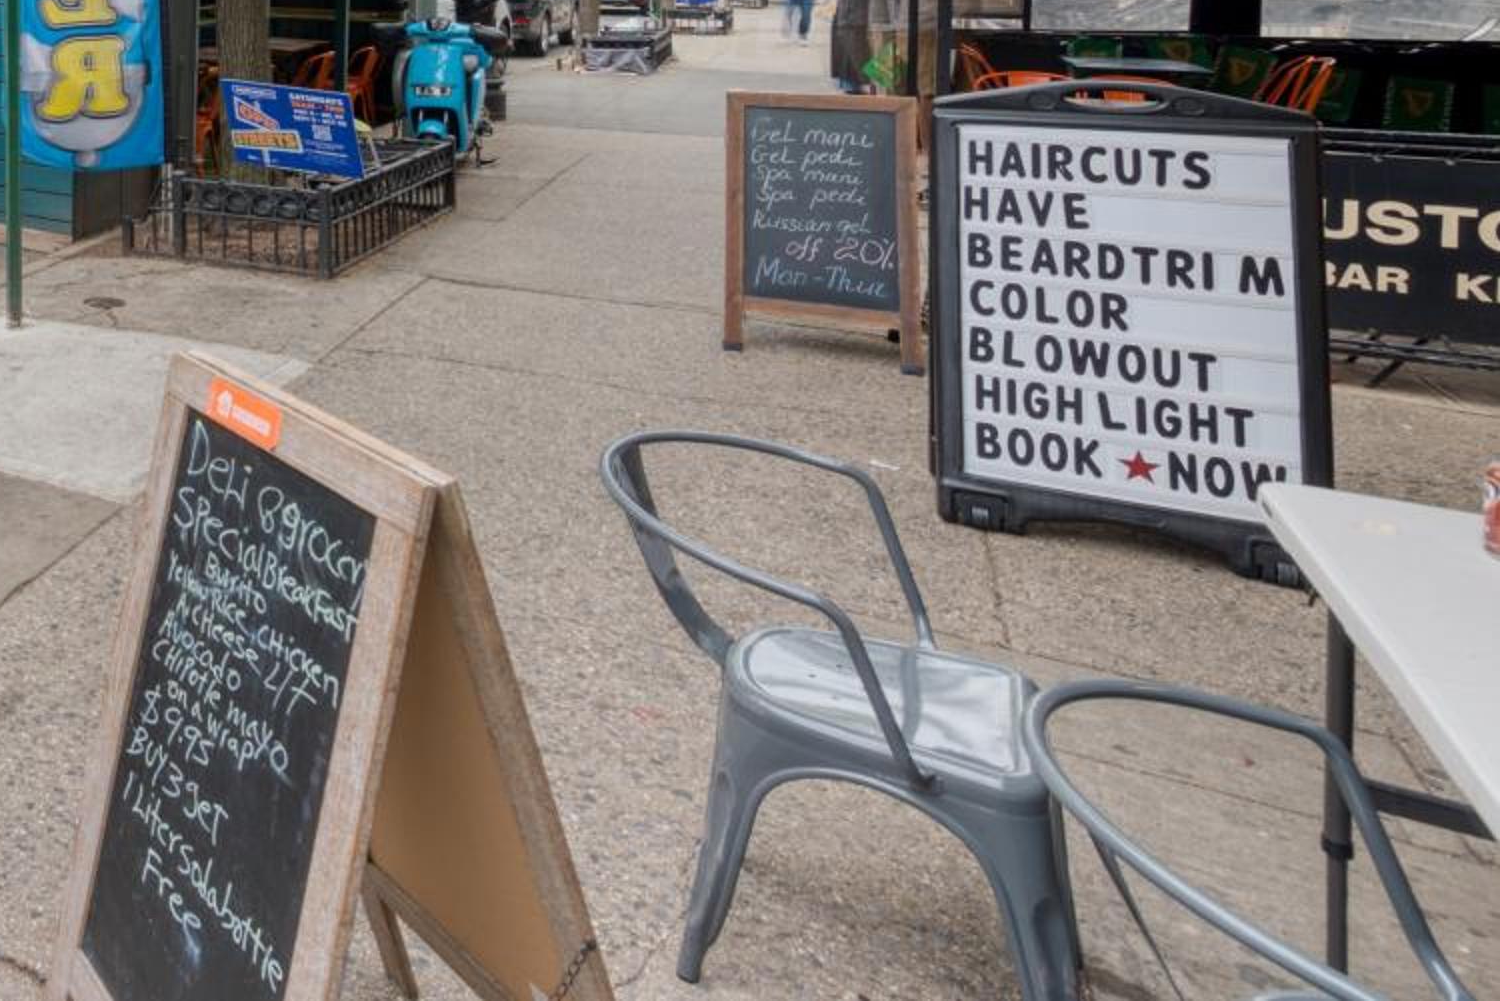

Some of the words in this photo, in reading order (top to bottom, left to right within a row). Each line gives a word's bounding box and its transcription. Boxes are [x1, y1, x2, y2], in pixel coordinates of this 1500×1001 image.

[234, 133, 298, 148] STREETS
[803, 124, 874, 149] mani
[968, 140, 1212, 190] HAIRCUTS
[963, 185, 1090, 230] HAVE
[785, 234, 823, 262] off
[833, 236, 896, 272] 20%
[969, 279, 1129, 332] COLOR
[969, 326, 1217, 392] BLOWOUT
[975, 421, 1103, 478] BOOK
[140, 684, 215, 767] $9.95
[161, 761, 185, 798] 3
